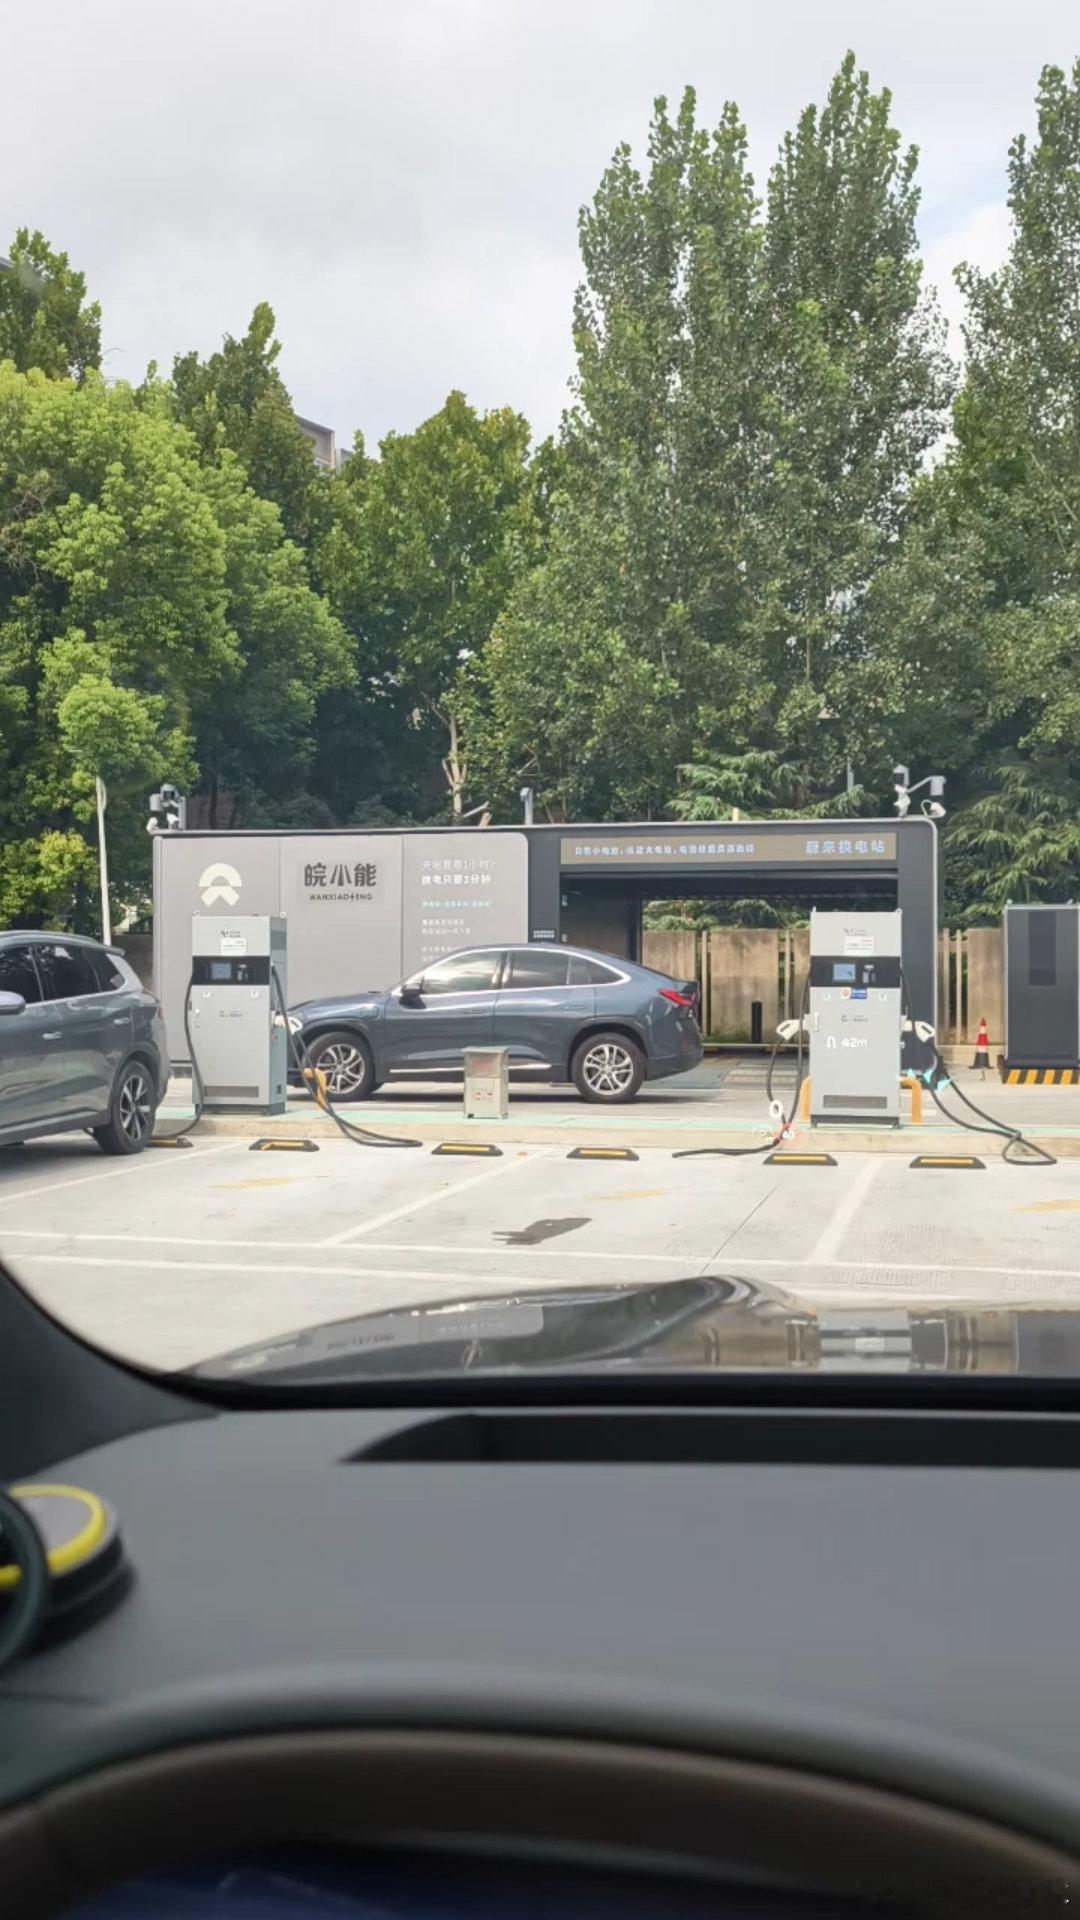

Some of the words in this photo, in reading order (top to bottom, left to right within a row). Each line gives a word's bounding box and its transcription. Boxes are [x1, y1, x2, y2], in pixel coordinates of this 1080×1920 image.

[806, 840, 885, 855] 蔚来换电站
[304, 862, 377, 887] 皖小能
[422, 874, 491, 886] 换电只要3分钟
[841, 1037, 868, 1048] 42m
